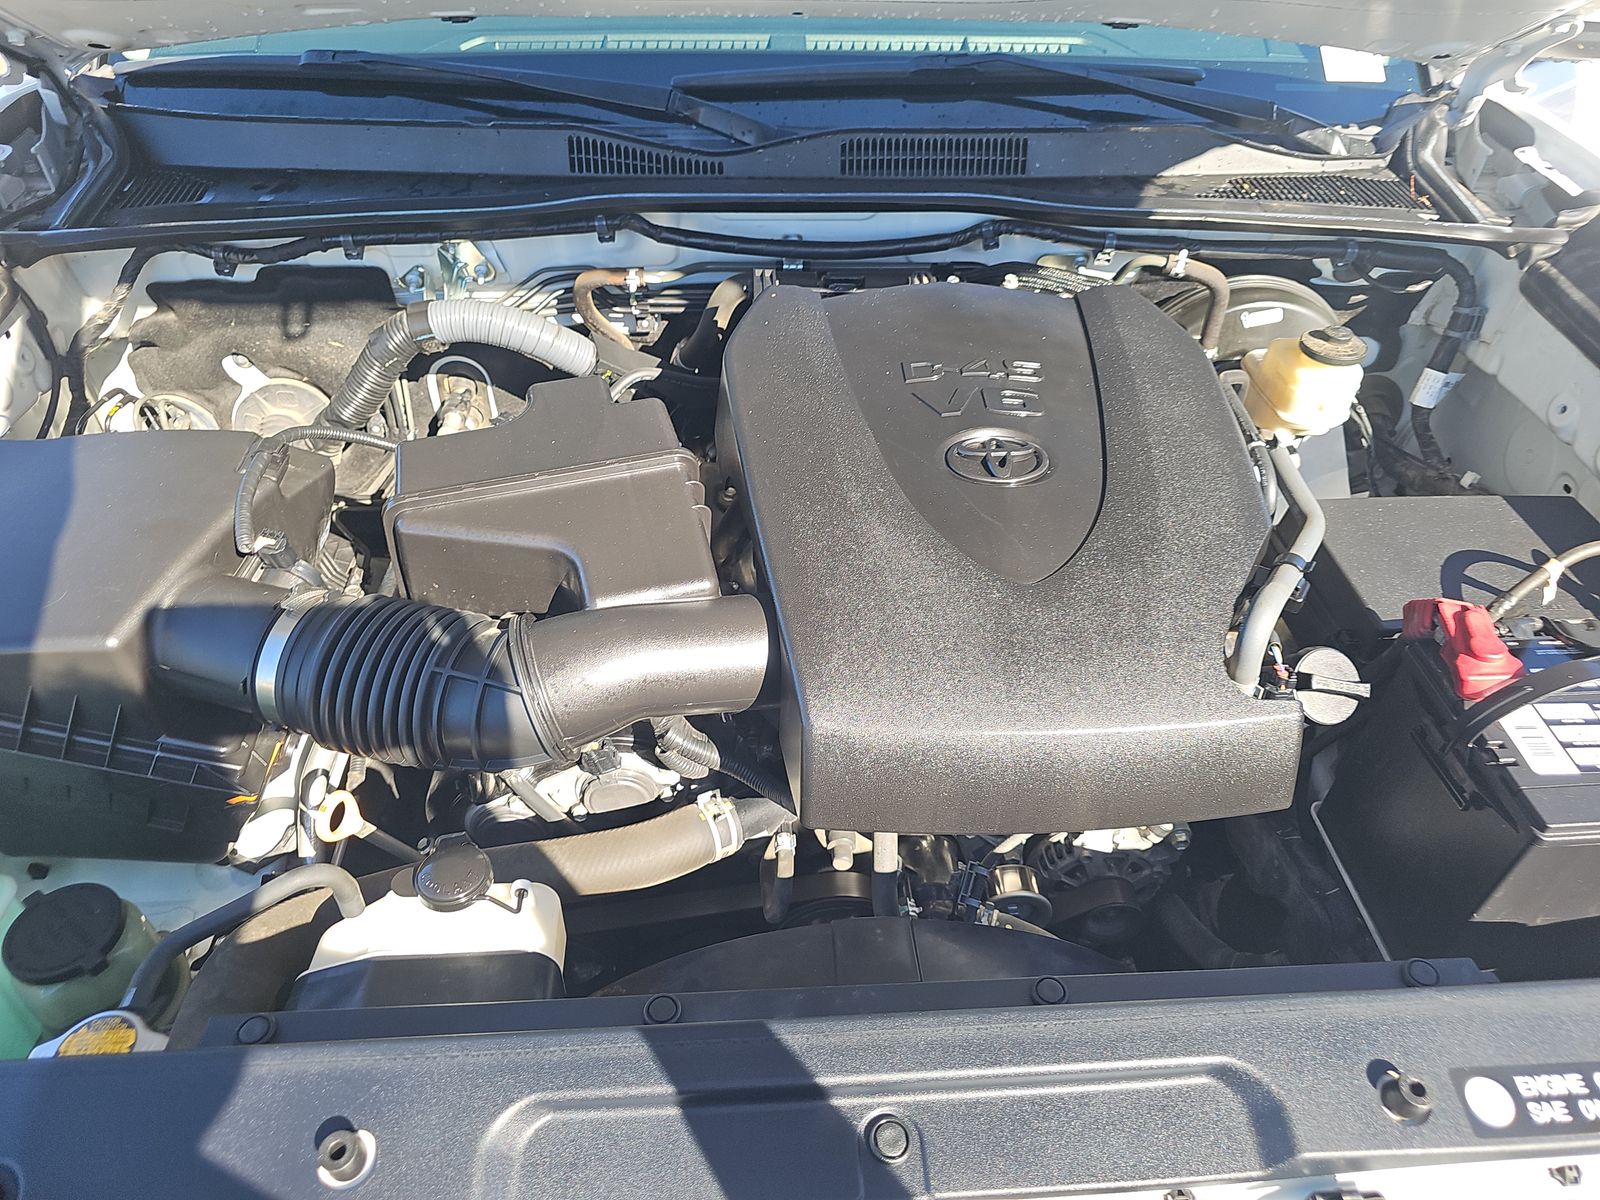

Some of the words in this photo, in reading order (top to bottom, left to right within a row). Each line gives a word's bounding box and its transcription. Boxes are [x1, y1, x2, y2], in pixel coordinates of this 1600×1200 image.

[900, 359, 1044, 384] D-4S
[911, 386, 1044, 418] V6
[1512, 1073, 1590, 1097] ENGINE
[1526, 1100, 1574, 1124] SAE
